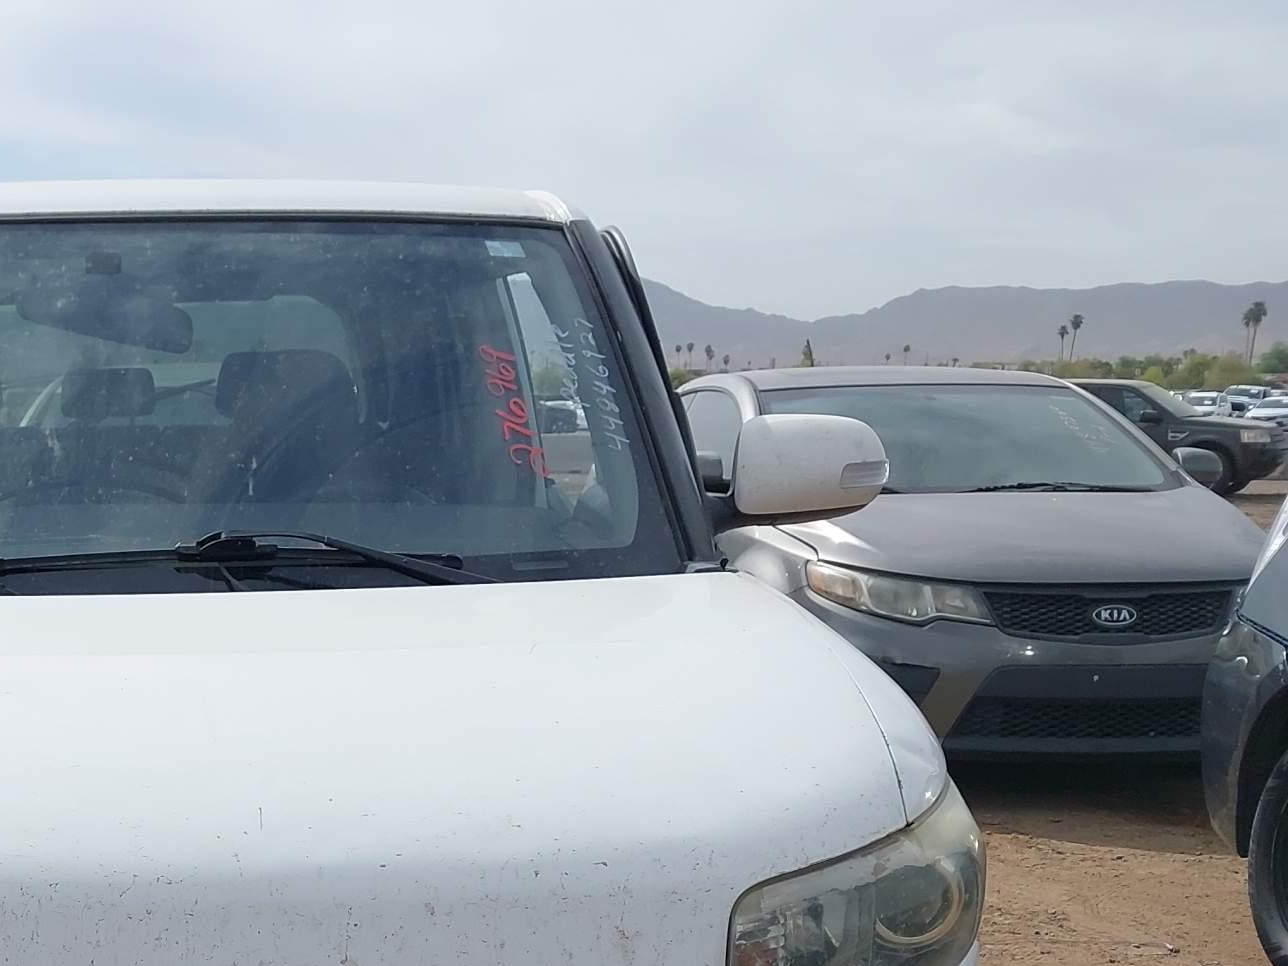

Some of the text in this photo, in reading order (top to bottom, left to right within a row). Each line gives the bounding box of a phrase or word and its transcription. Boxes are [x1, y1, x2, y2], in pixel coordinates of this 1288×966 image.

[479, 343, 552, 479] 276969
[573, 317, 631, 451] 44846927
[1100, 608, 1131, 621] KIA
